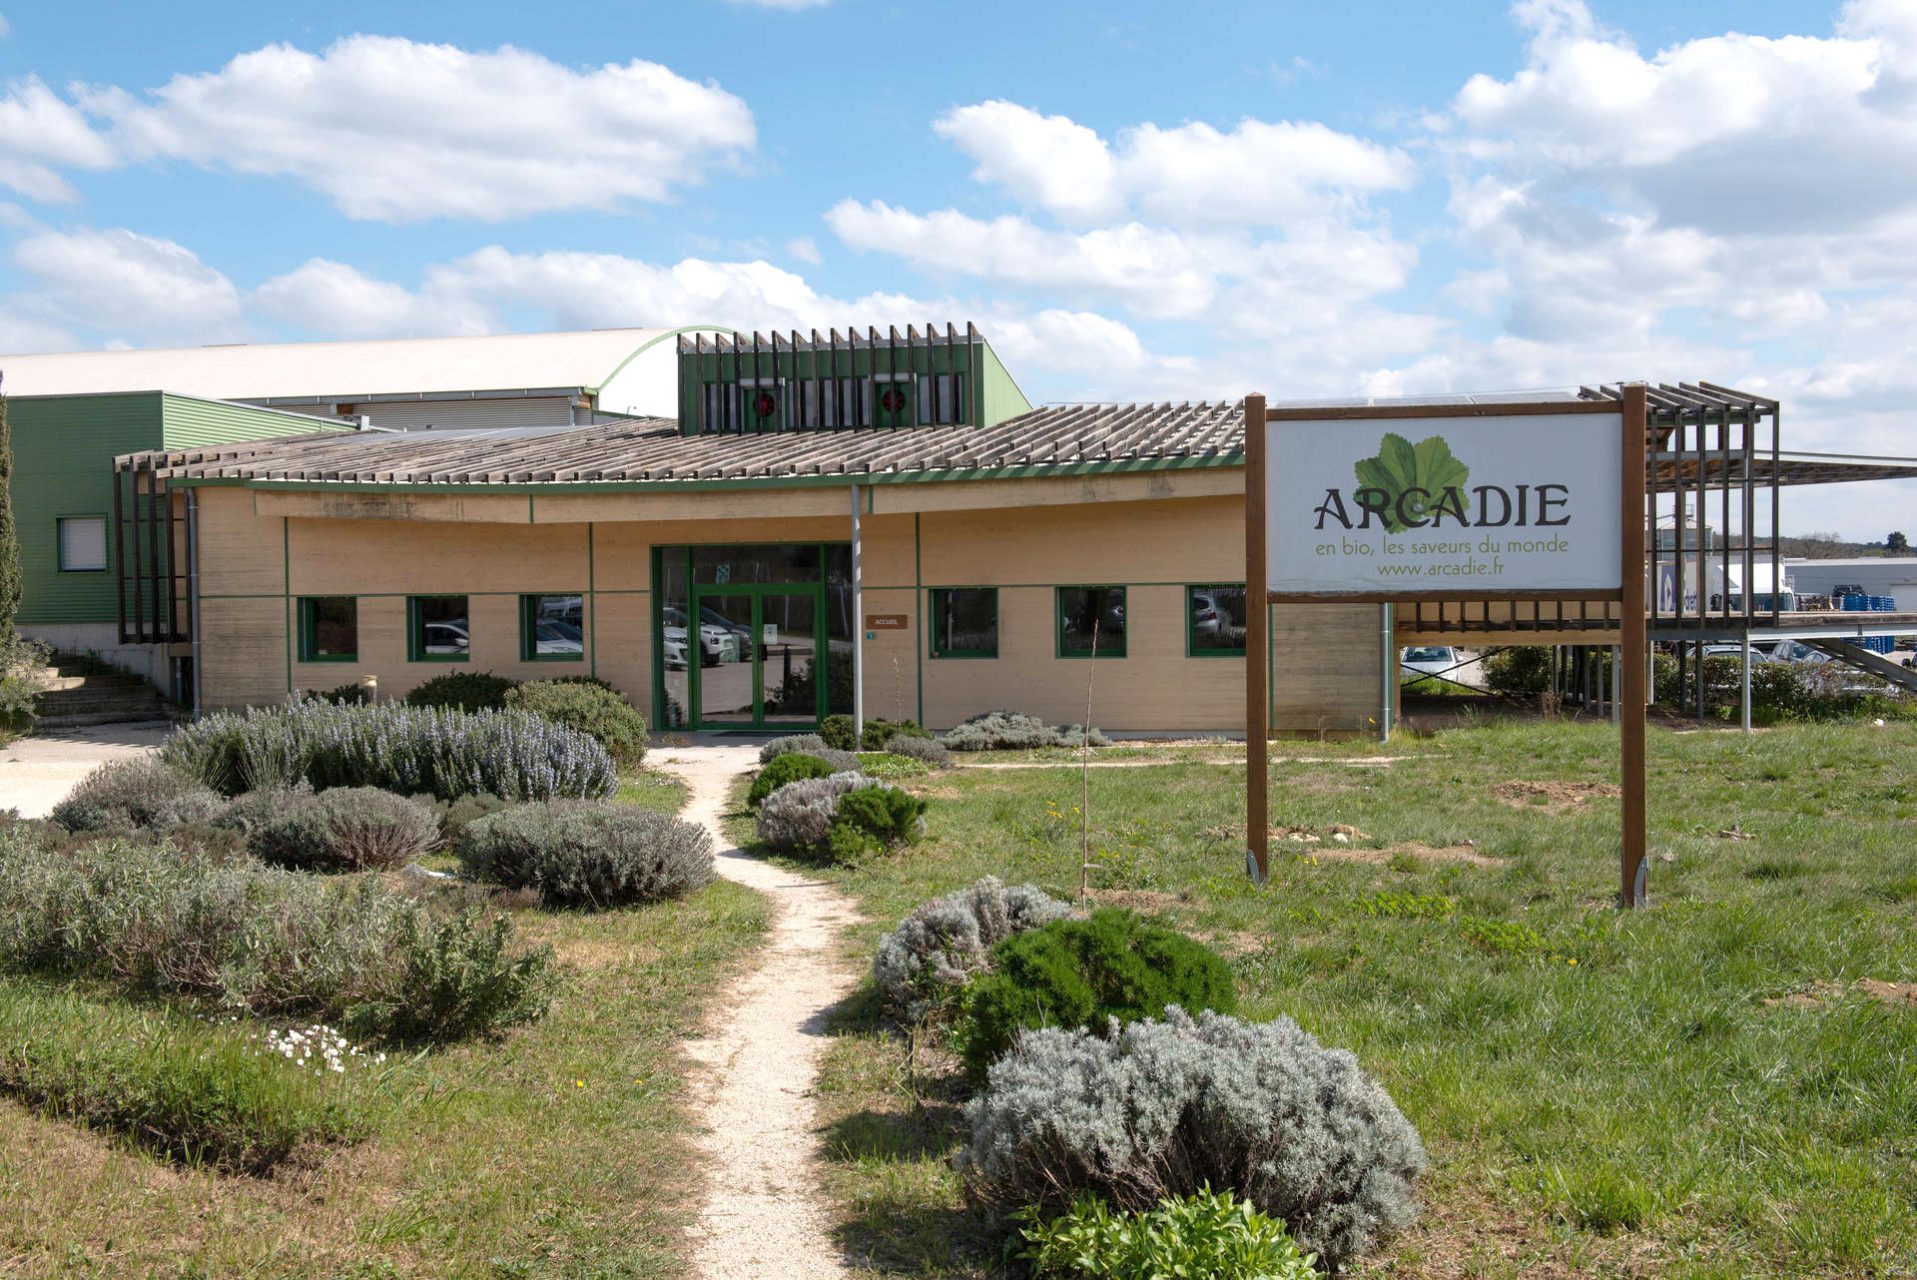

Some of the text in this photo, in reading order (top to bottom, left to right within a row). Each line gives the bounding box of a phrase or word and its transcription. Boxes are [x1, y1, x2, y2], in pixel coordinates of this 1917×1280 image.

[1314, 484, 1571, 530] ARCADIE
[1315, 532, 1569, 557] en bio, les saveurs du monde
[1377, 555, 1504, 576] www.arcadie.fr
